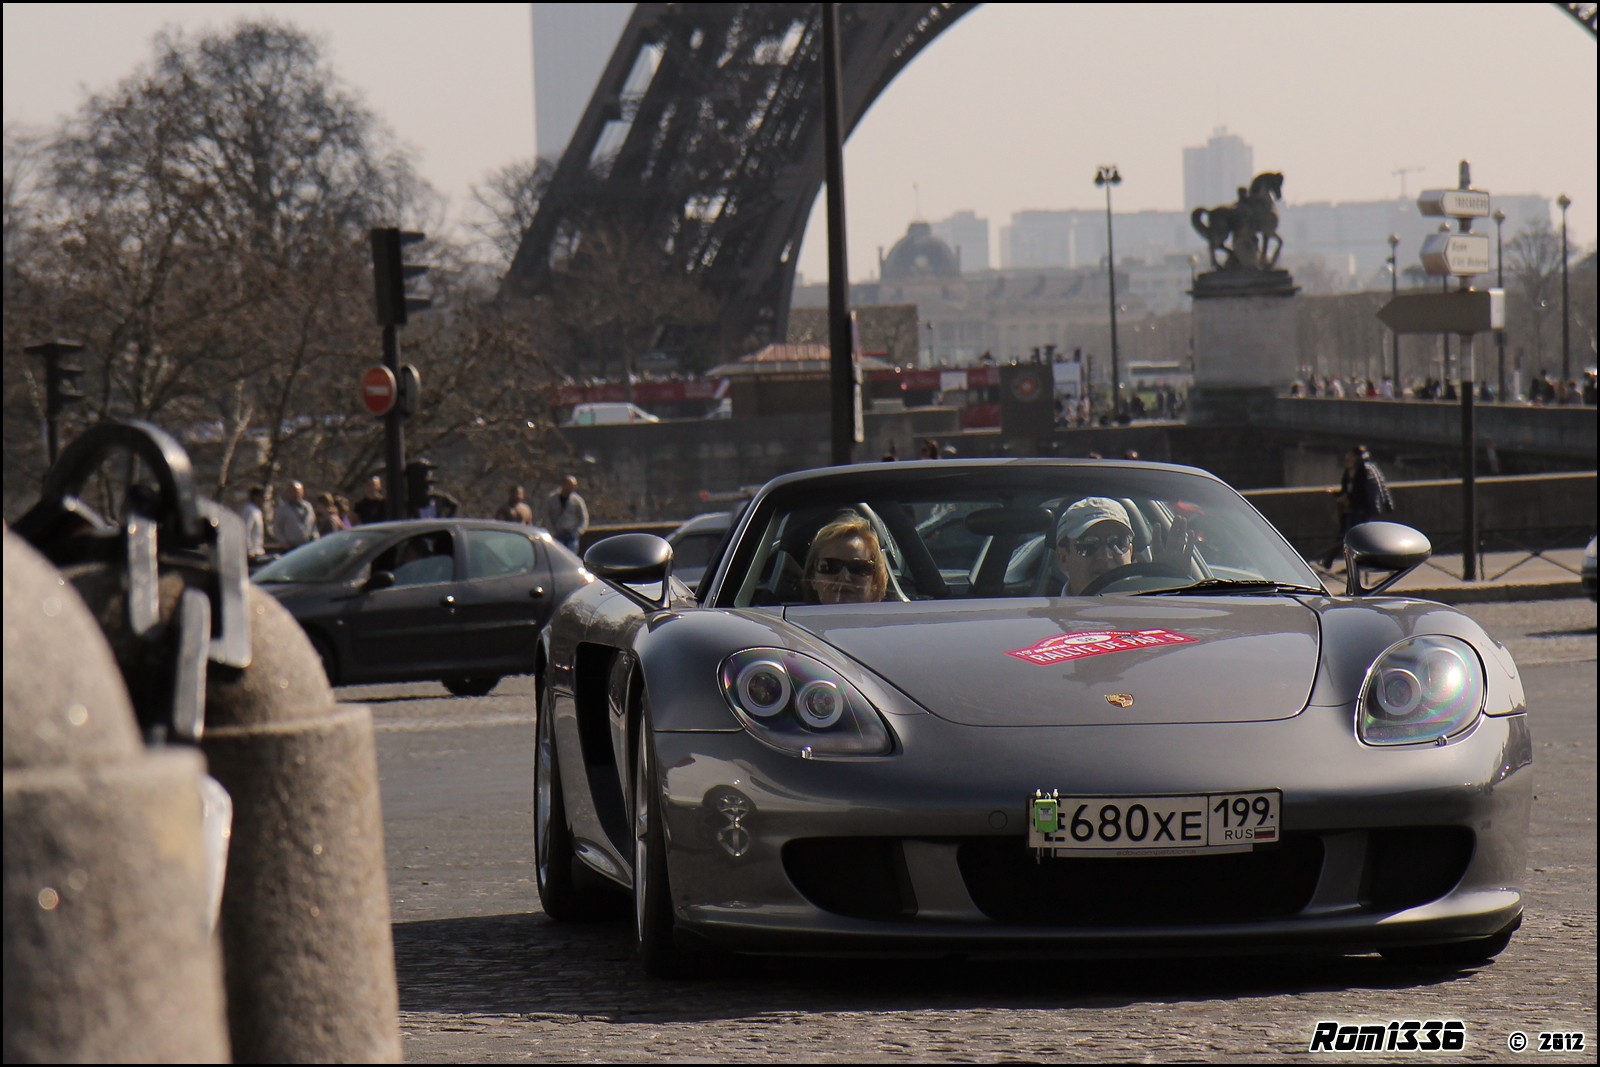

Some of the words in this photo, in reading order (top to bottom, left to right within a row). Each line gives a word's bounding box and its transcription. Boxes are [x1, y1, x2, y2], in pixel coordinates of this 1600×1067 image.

[1029, 645, 1100, 662] RALLYE
[1094, 640, 1127, 650] DE
[1121, 633, 1184, 646] PARS
[1213, 797, 1270, 828] 199
[1224, 828, 1253, 841] RUS
